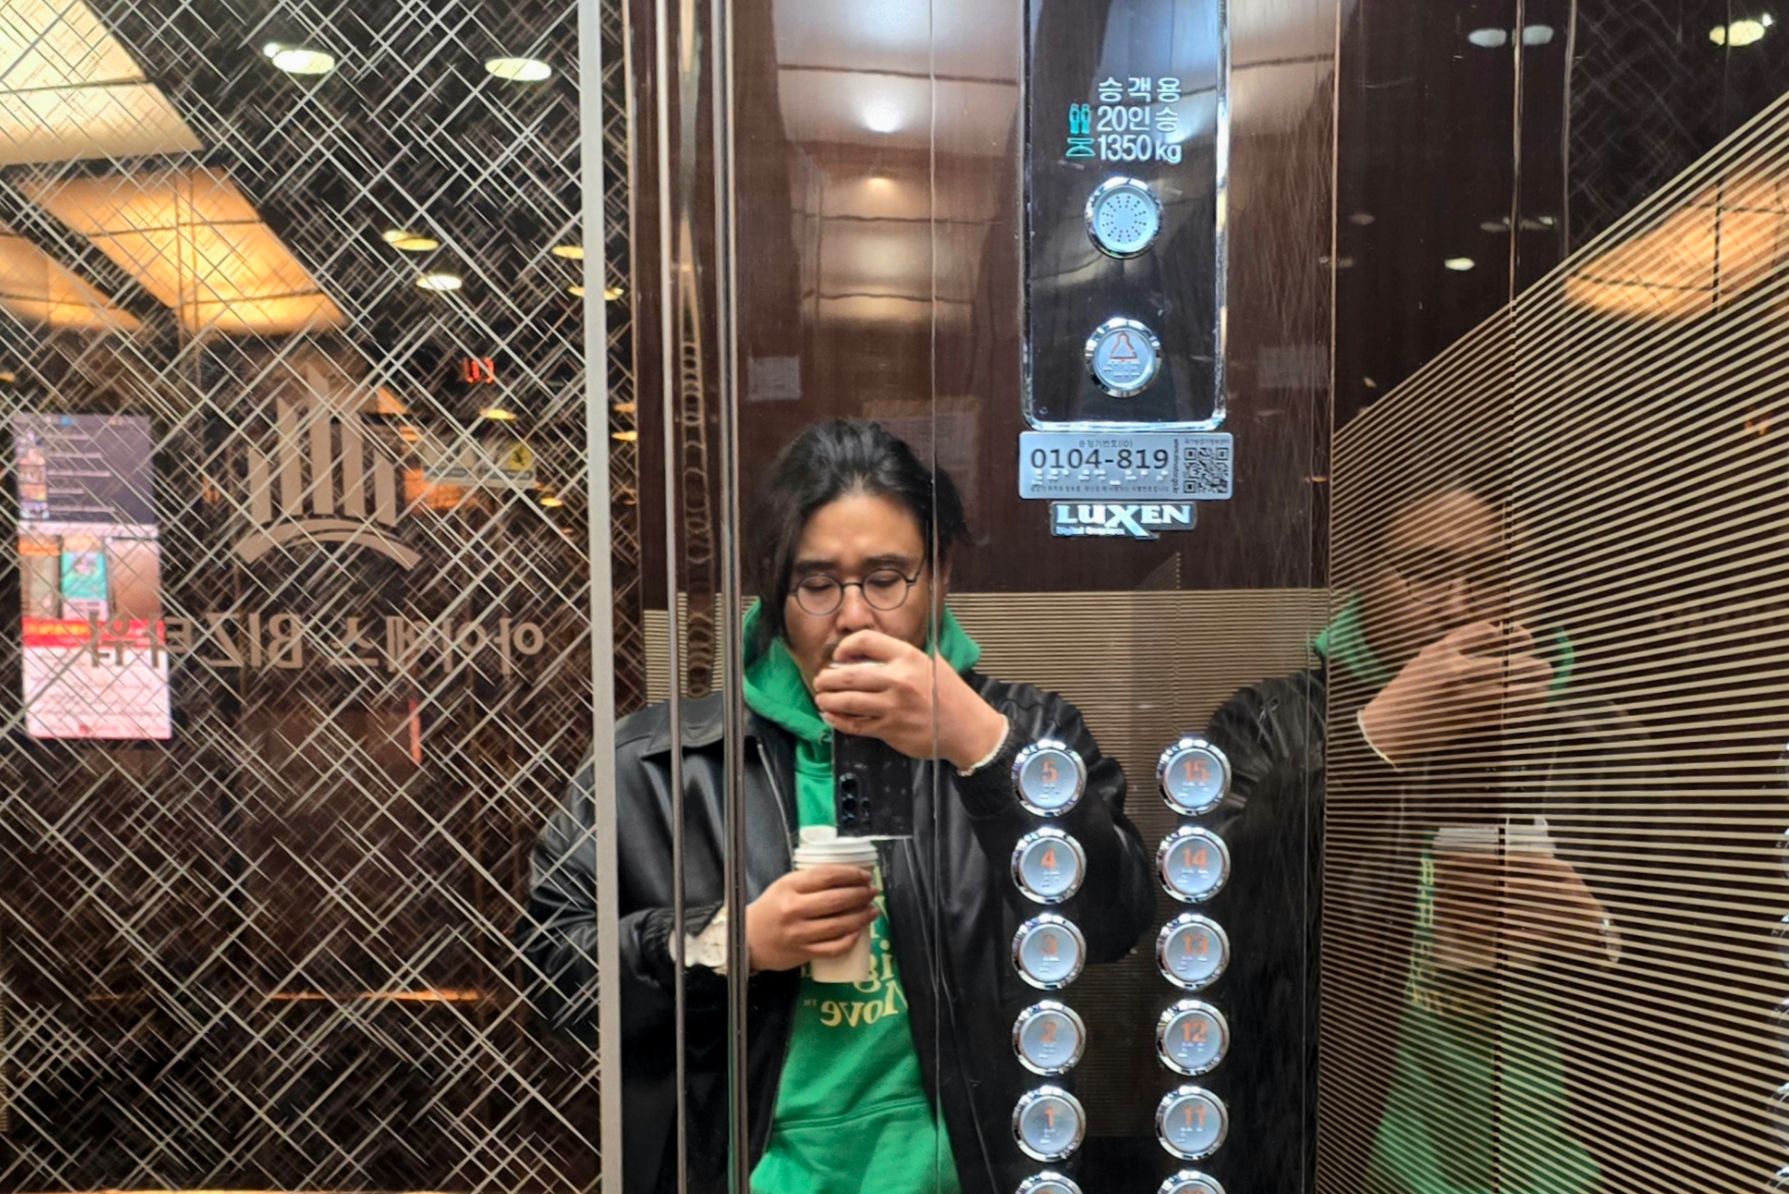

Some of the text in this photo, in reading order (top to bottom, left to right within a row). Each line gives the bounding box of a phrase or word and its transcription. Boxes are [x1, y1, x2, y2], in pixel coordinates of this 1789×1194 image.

[1098, 77, 1181, 102] 승객용
[1097, 105, 1179, 132] 20인승
[1030, 448, 1169, 469] 0104-819
[1056, 504, 1191, 537] LUXEN
[1041, 759, 1058, 782] 5
[1183, 759, 1209, 782] 15
[1041, 848, 1057, 870] 4
[1183, 848, 1208, 869] 14
[1041, 935, 1057, 956] 3
[1183, 934, 1209, 955] 13
[1041, 1020, 1057, 1042] 2
[1182, 1020, 1208, 1042] 12
[1044, 1106, 1055, 1126] 1
[1183, 1106, 1206, 1126] 11
